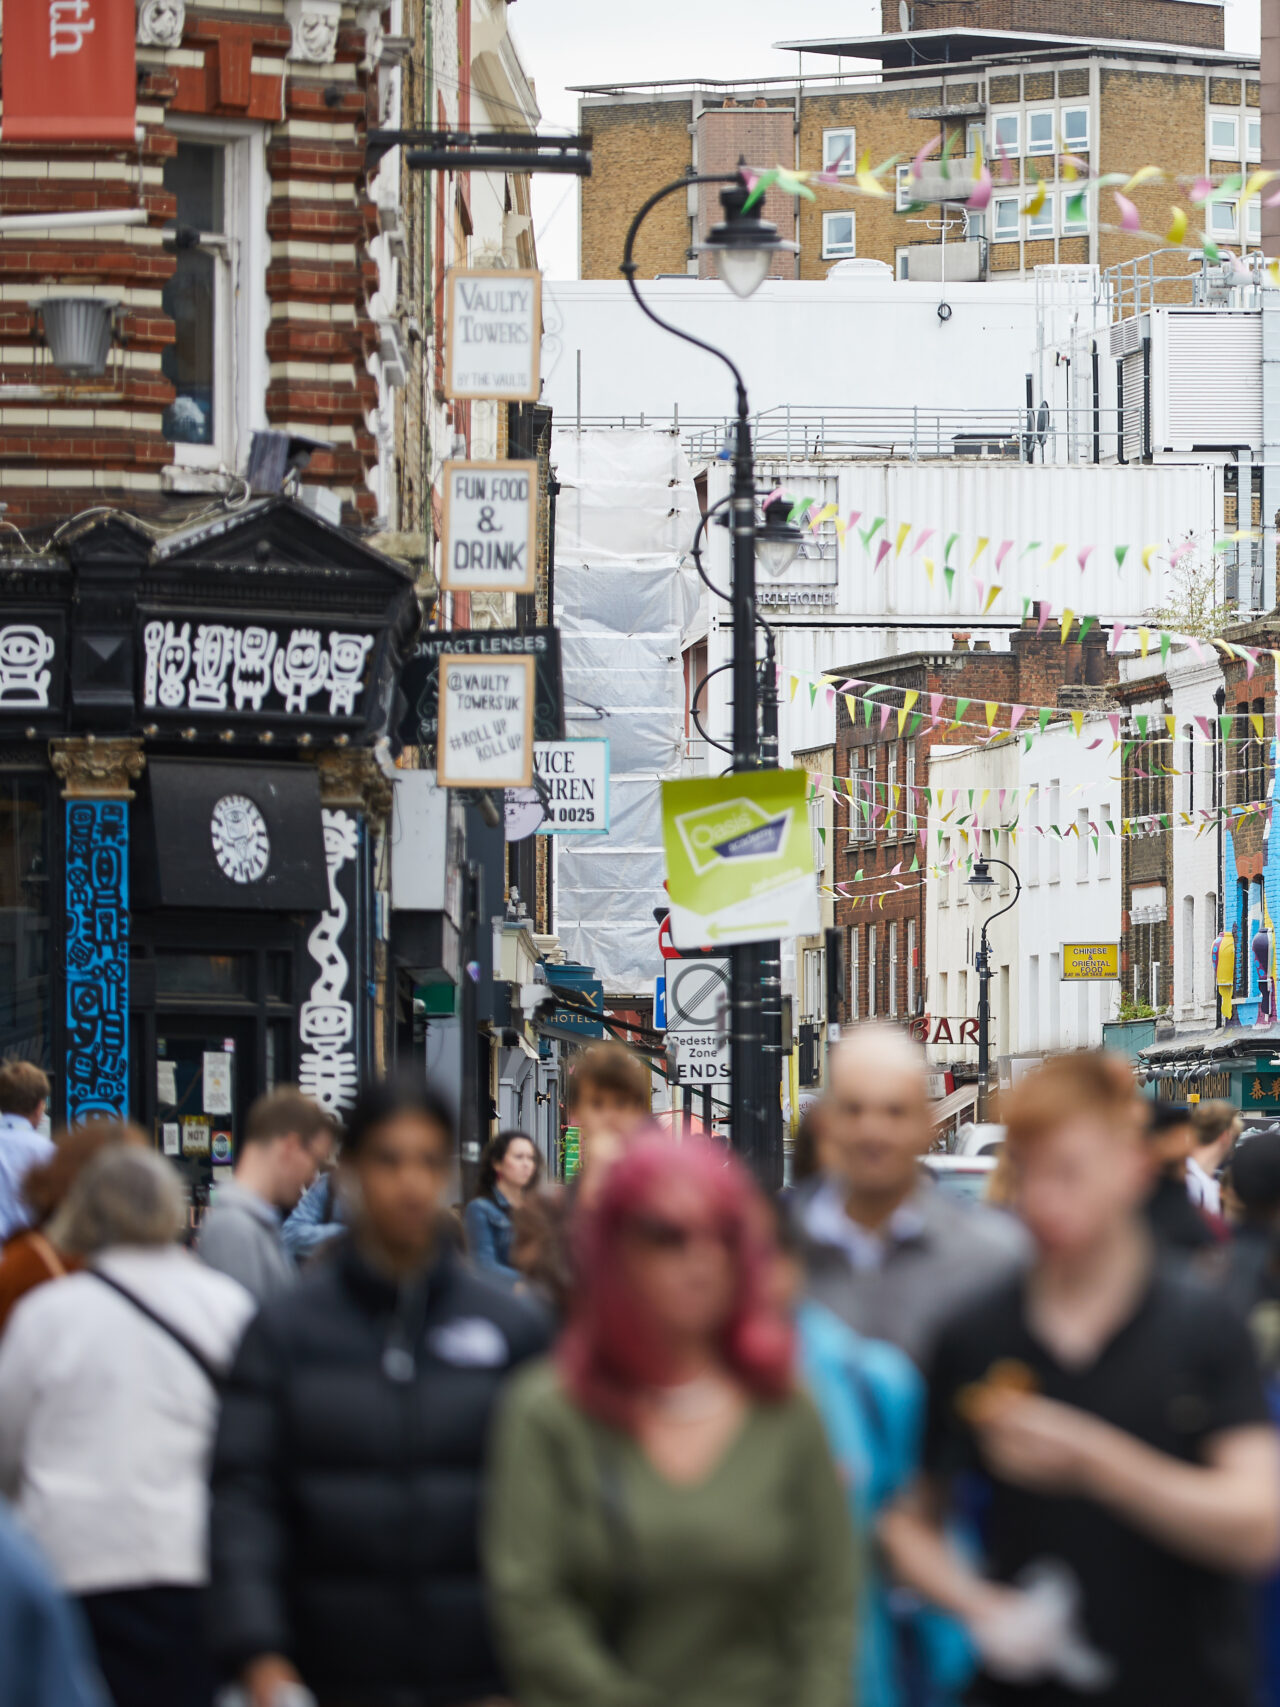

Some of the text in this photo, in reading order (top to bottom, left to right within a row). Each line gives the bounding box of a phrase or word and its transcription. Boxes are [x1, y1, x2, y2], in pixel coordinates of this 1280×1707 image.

[458, 282, 529, 312] VAULTY
[459, 315, 529, 344] TOWERS
[472, 373, 489, 386] THE
[491, 478, 529, 501] FOOD
[477, 505, 504, 534] &
[454, 541, 526, 570] DRINK
[481, 636, 547, 651] LENSES
[447, 672, 510, 691] @VAULTY
[493, 718, 507, 736] UP
[476, 734, 522, 762] ROLL UP
[559, 807, 595, 822] 0025
[909, 1017, 980, 1046] BAR
[672, 1036, 731, 1046] edestr
[689, 1048, 718, 1058] Zone
[677, 1064, 732, 1078] ENDS
[187, 1130, 205, 1141] NOT
